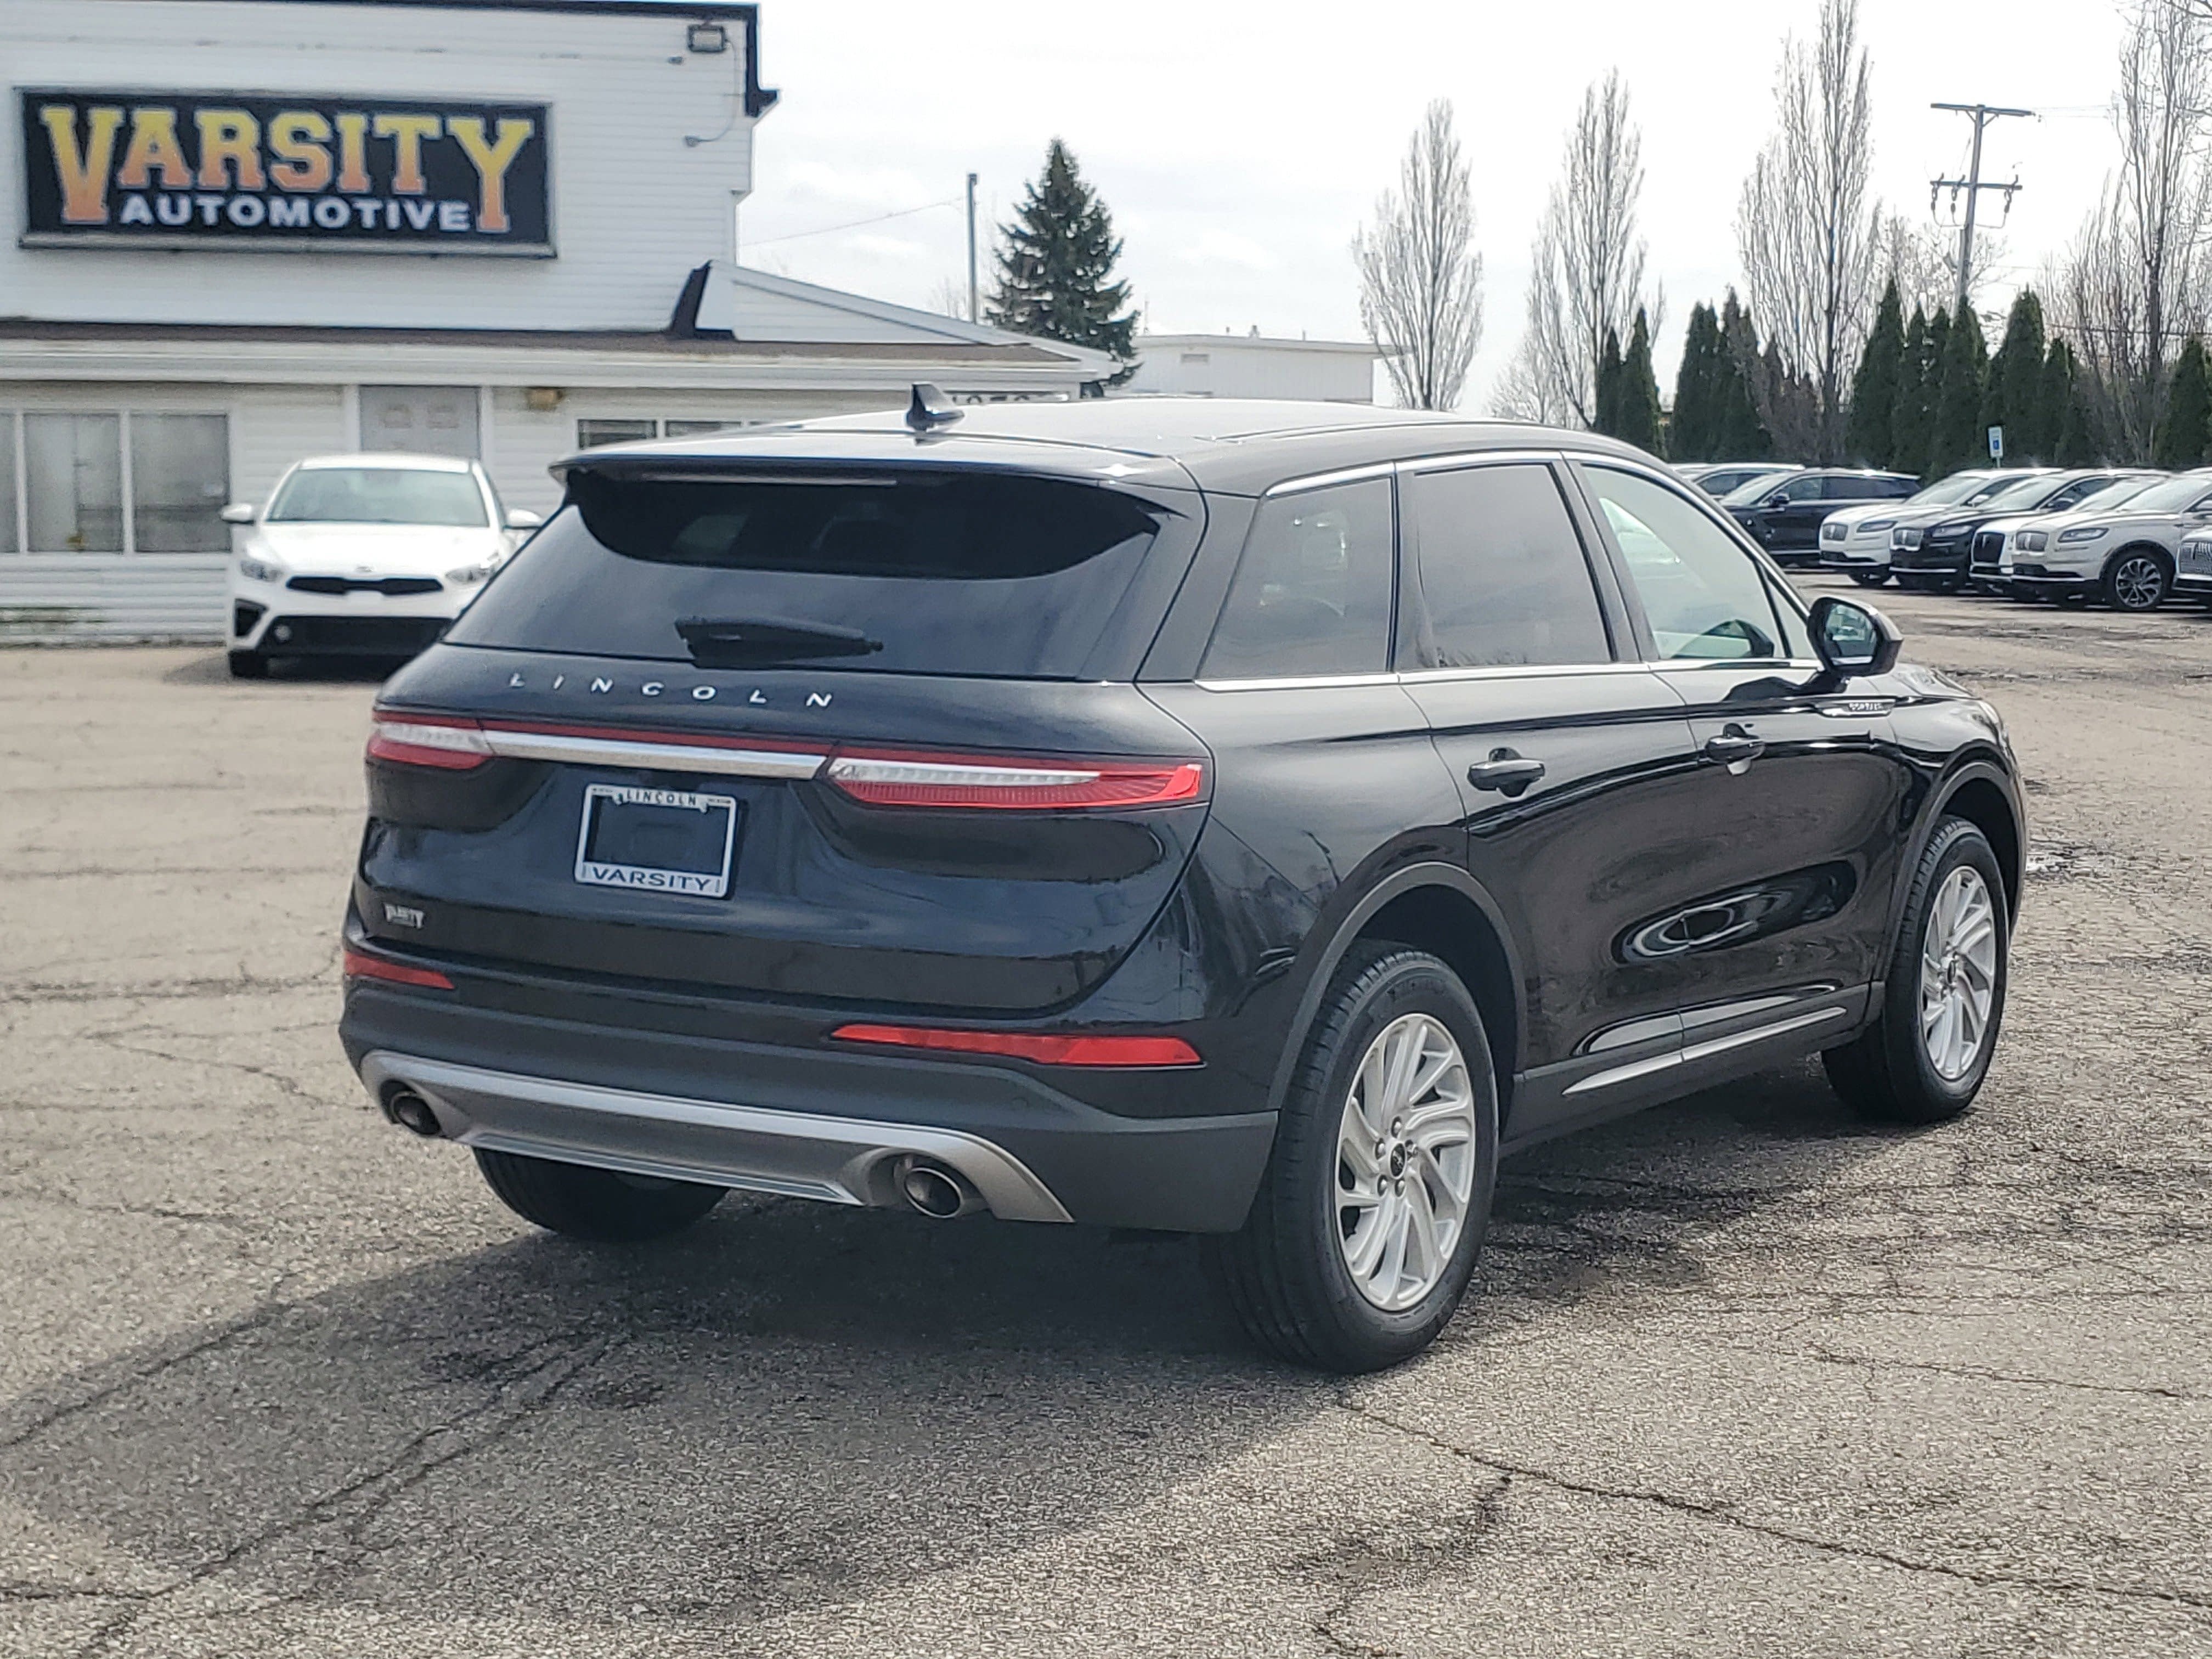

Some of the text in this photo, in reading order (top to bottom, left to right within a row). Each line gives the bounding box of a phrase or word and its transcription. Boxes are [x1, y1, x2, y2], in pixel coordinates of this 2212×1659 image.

[40, 104, 534, 233] VARSITY
[120, 194, 471, 232] AUTOMOTIVE
[509, 673, 832, 708] LINCOLN
[627, 789, 697, 806] LINCOLN
[592, 866, 711, 891] VARSITY
